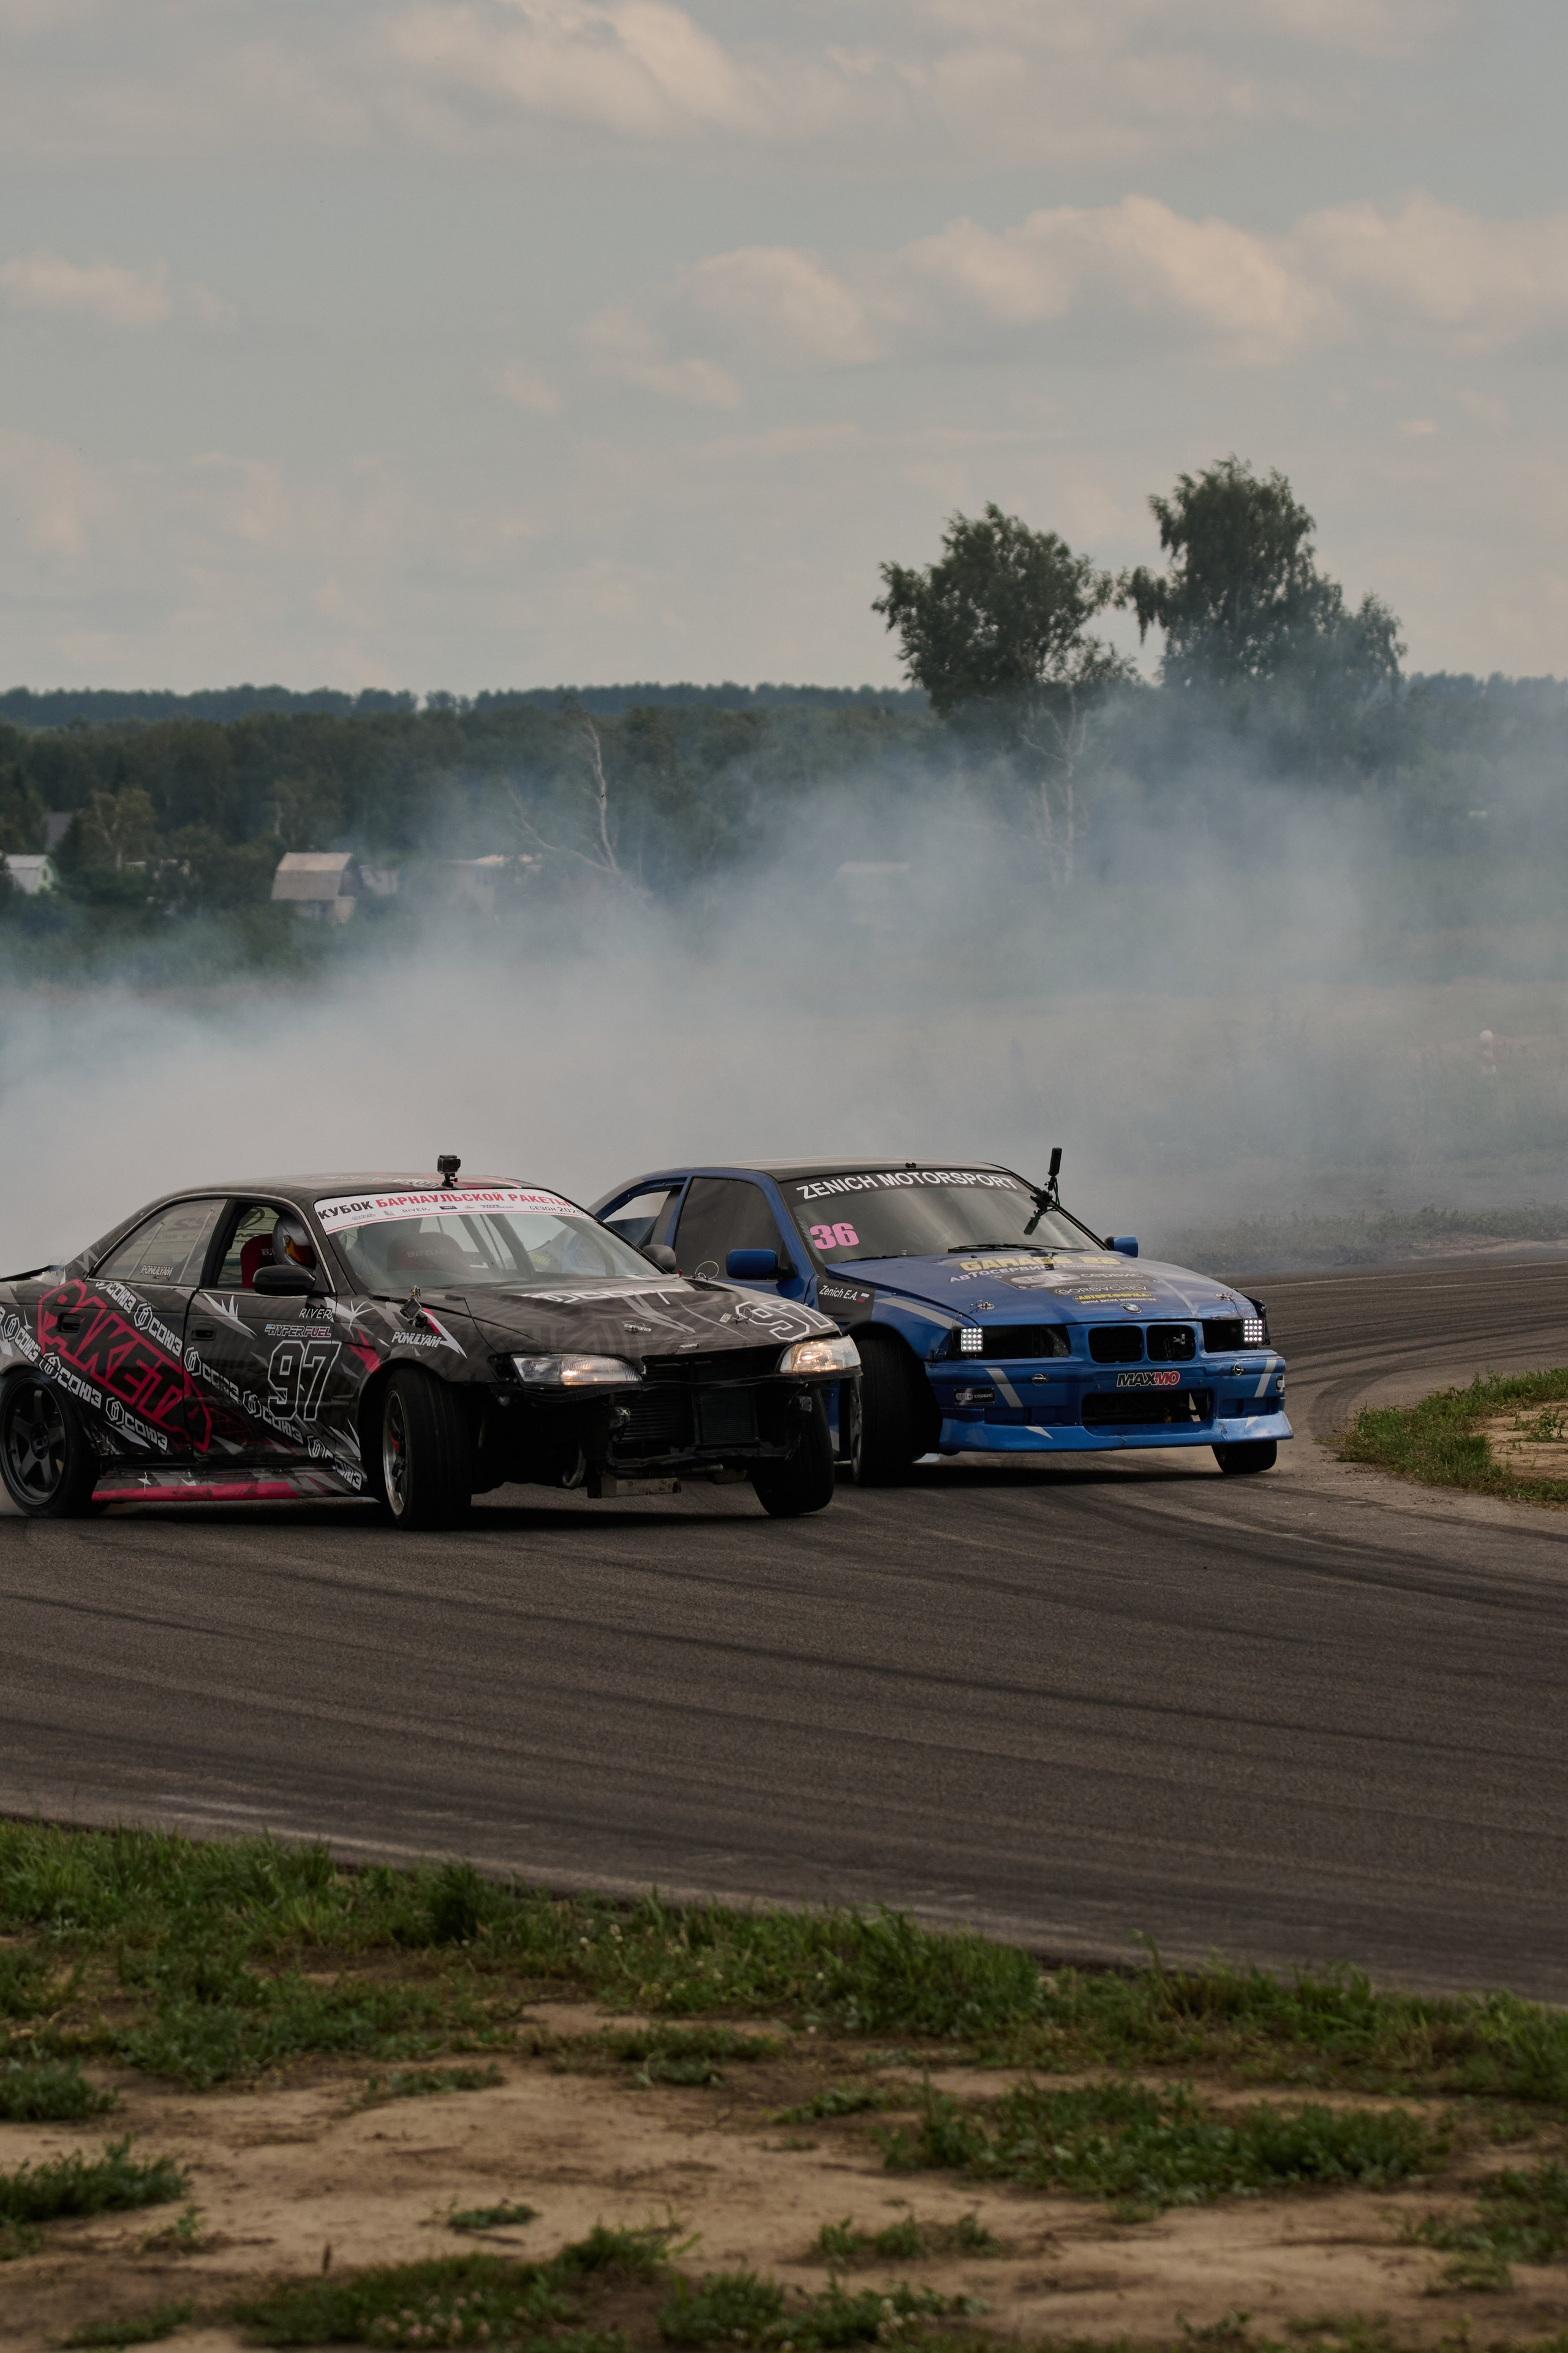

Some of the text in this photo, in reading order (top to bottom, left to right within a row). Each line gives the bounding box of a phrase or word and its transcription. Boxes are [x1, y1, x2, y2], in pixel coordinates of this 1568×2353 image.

[796, 1172, 1018, 1200] ZENICH MOTORSPORT
[317, 1192, 571, 1220] КУБОК БАРНАУЛЬСКОЙ РАКЕТЫ
[809, 1222, 860, 1250] 36
[140, 1264, 174, 1276] PONULYAM
[950, 1265, 1050, 1282] АВТОСЕРВИС
[960, 1256, 1121, 1271] GARAGE 22
[106, 1282, 137, 1314] СОЮЗ
[819, 1284, 858, 1301] Zenich E.A.
[299, 1308, 333, 1320] RIVER
[735, 1300, 834, 1341] 97
[15, 1327, 41, 1363] СОЮЗ
[148, 1316, 183, 1357] СОЮЗ
[391, 1331, 442, 1348] PONULYAM
[57, 1371, 102, 1409] СОЮЗ
[268, 1341, 342, 1421] 97
[1116, 1371, 1180, 1388] MAXMO
[123, 1410, 168, 1451] СОЮЗ
